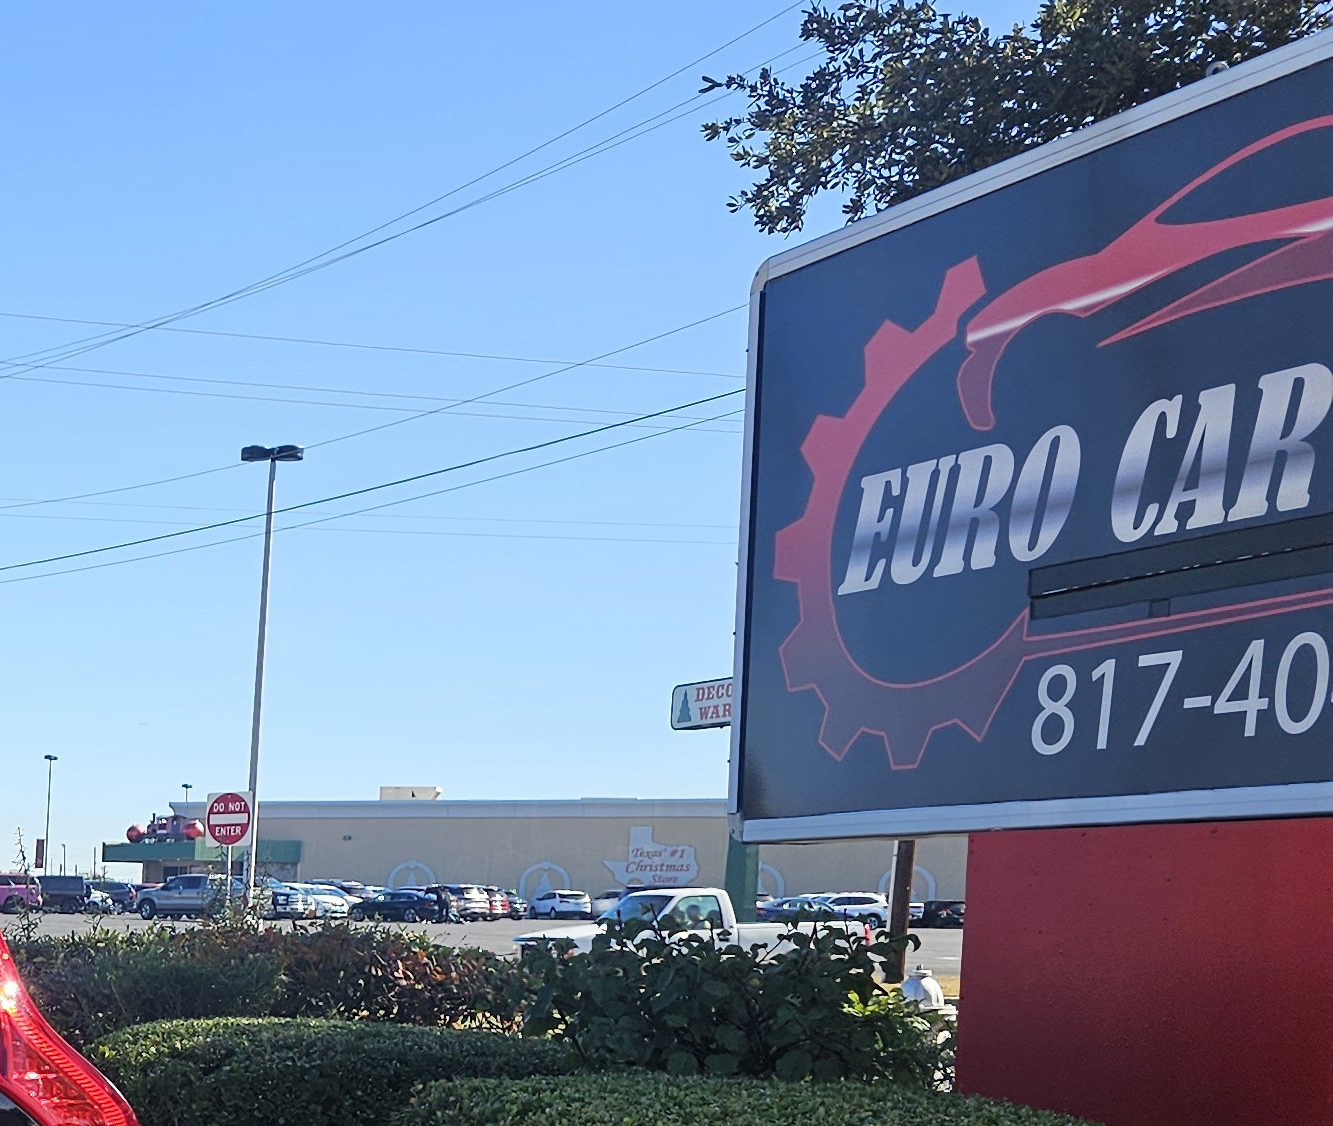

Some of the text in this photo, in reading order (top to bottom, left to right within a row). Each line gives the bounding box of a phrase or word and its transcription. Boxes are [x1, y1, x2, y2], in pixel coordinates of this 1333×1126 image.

[838, 362, 1333, 595] EURO CAR
[1031, 631, 1333, 756] 817-40
[213, 801, 245, 812] DO NOT
[215, 825, 242, 836] ENTER
[625, 860, 691, 873] Christmas
